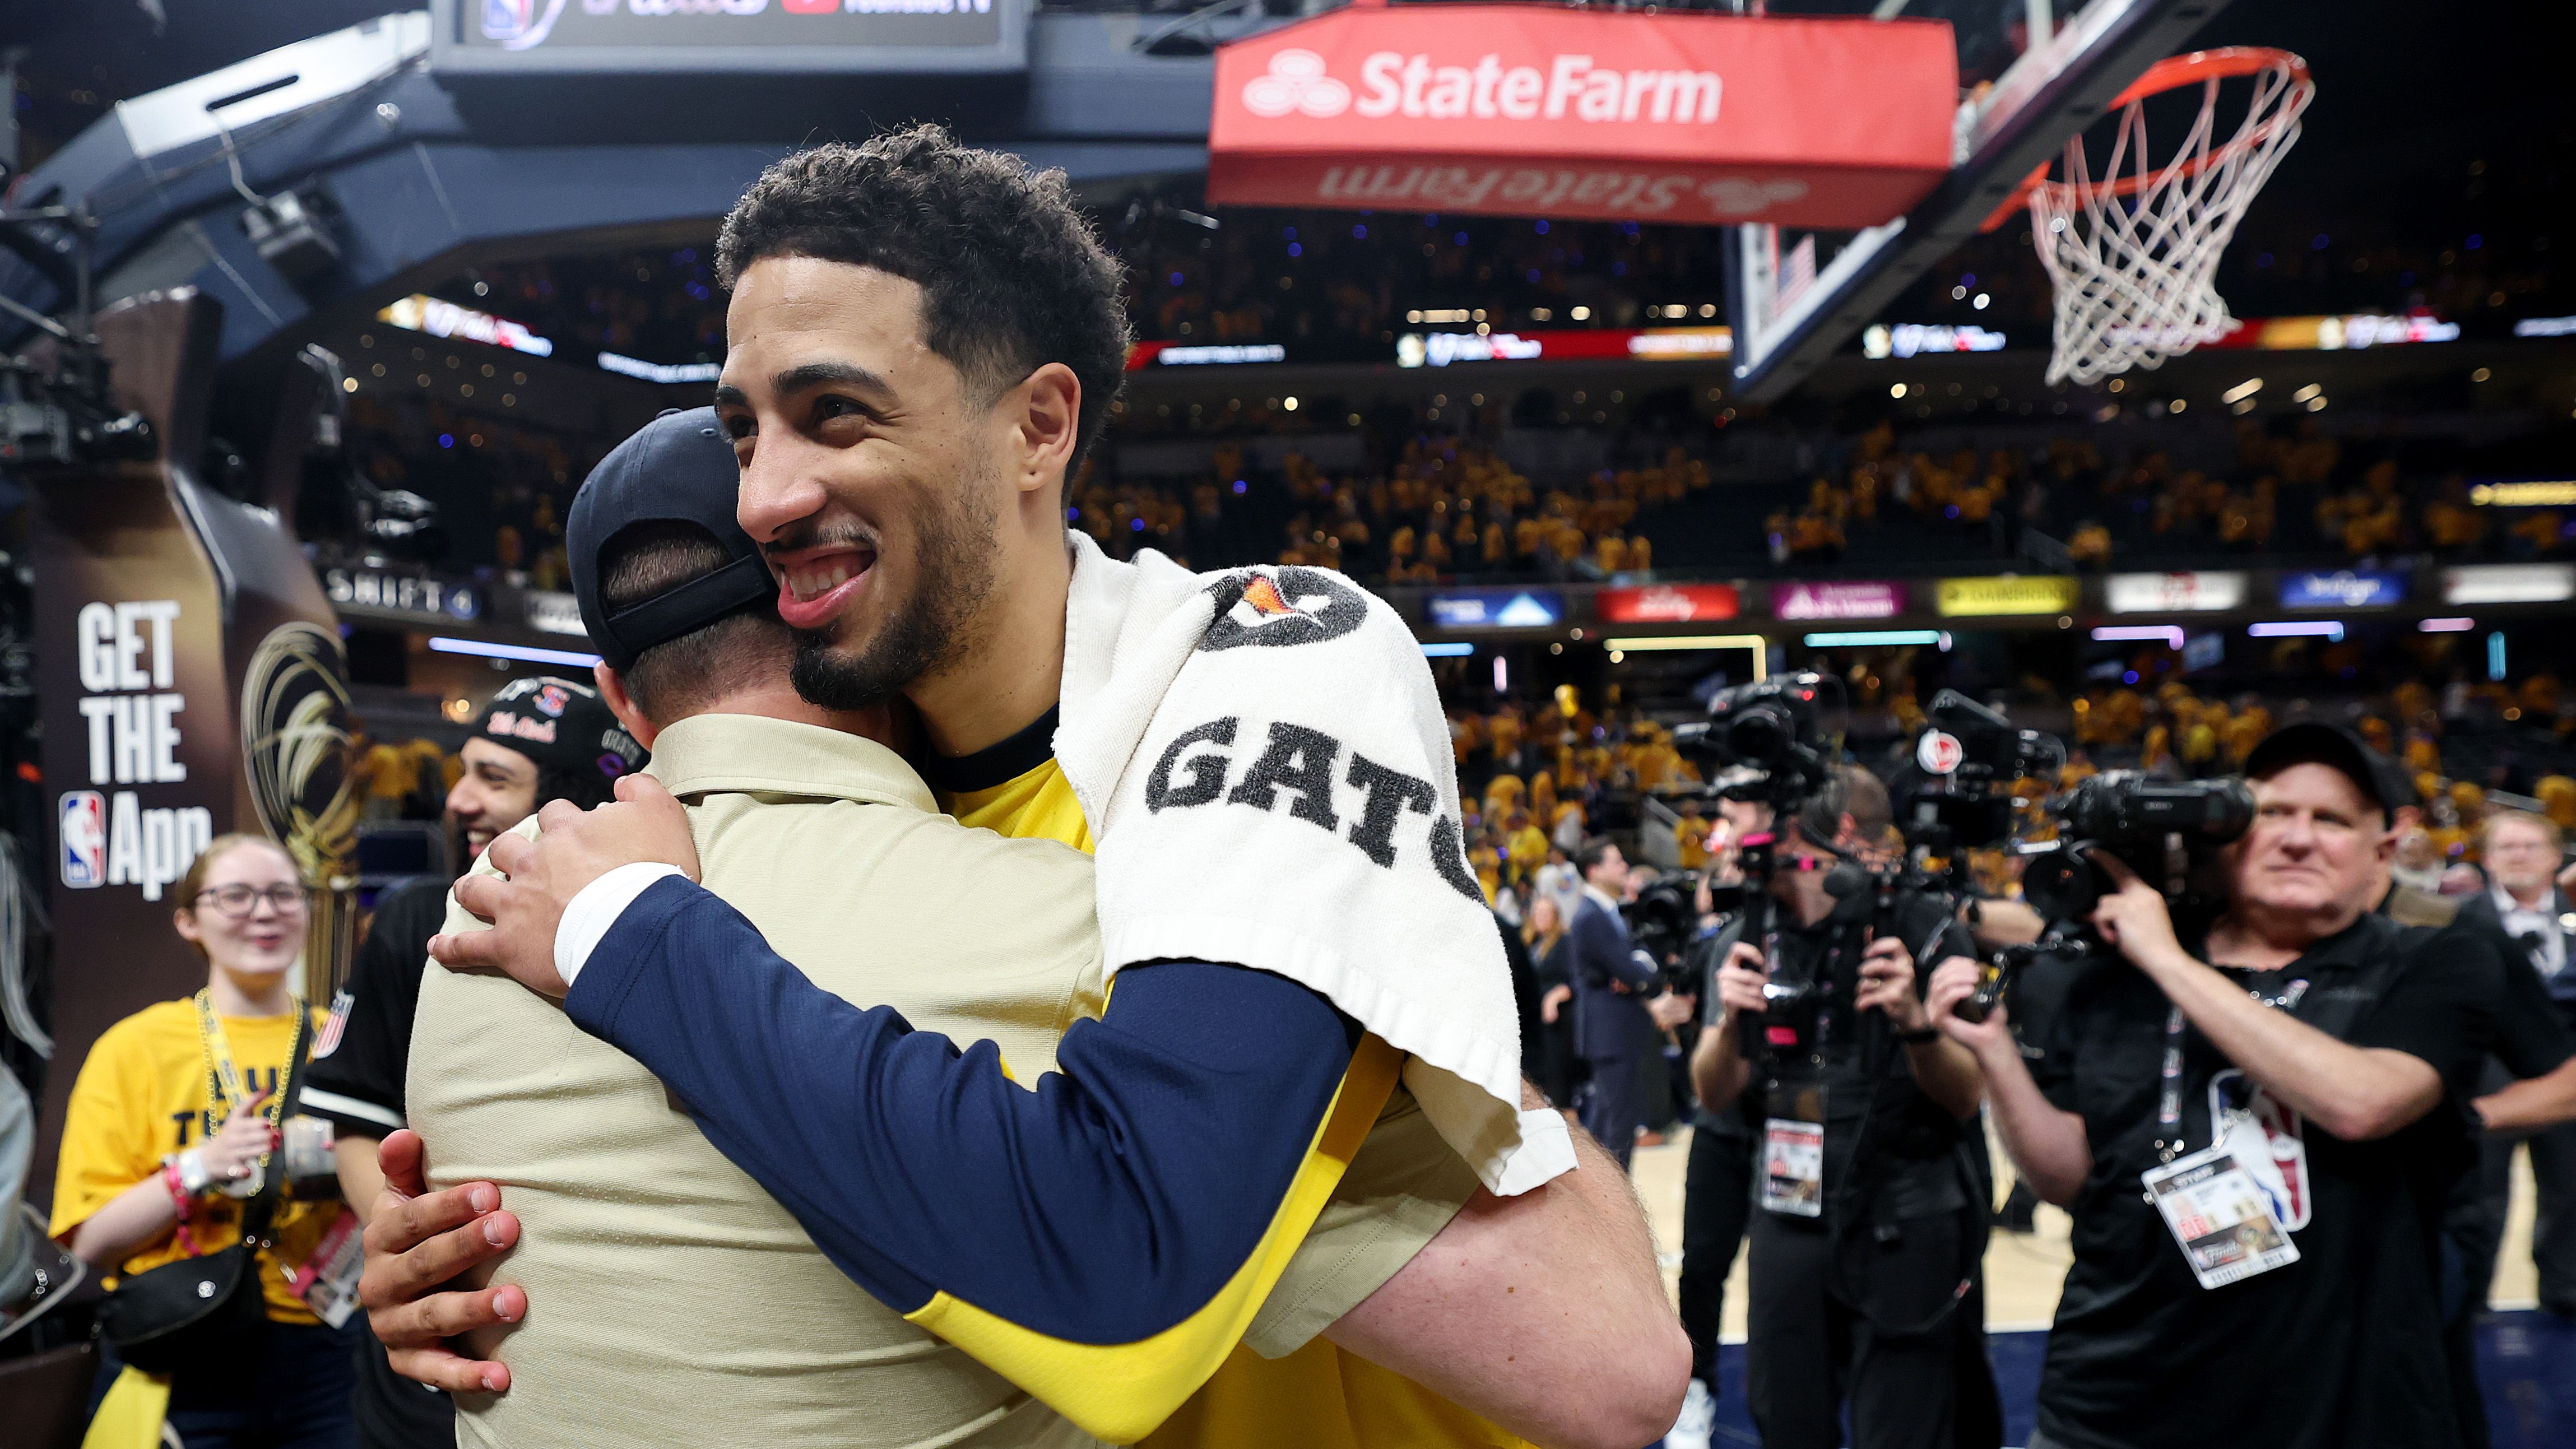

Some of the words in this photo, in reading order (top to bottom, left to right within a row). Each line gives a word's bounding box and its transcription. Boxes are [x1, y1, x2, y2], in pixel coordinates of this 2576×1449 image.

[78, 600, 181, 691] GET
[79, 693, 187, 784] THE
[108, 791, 212, 901] App
